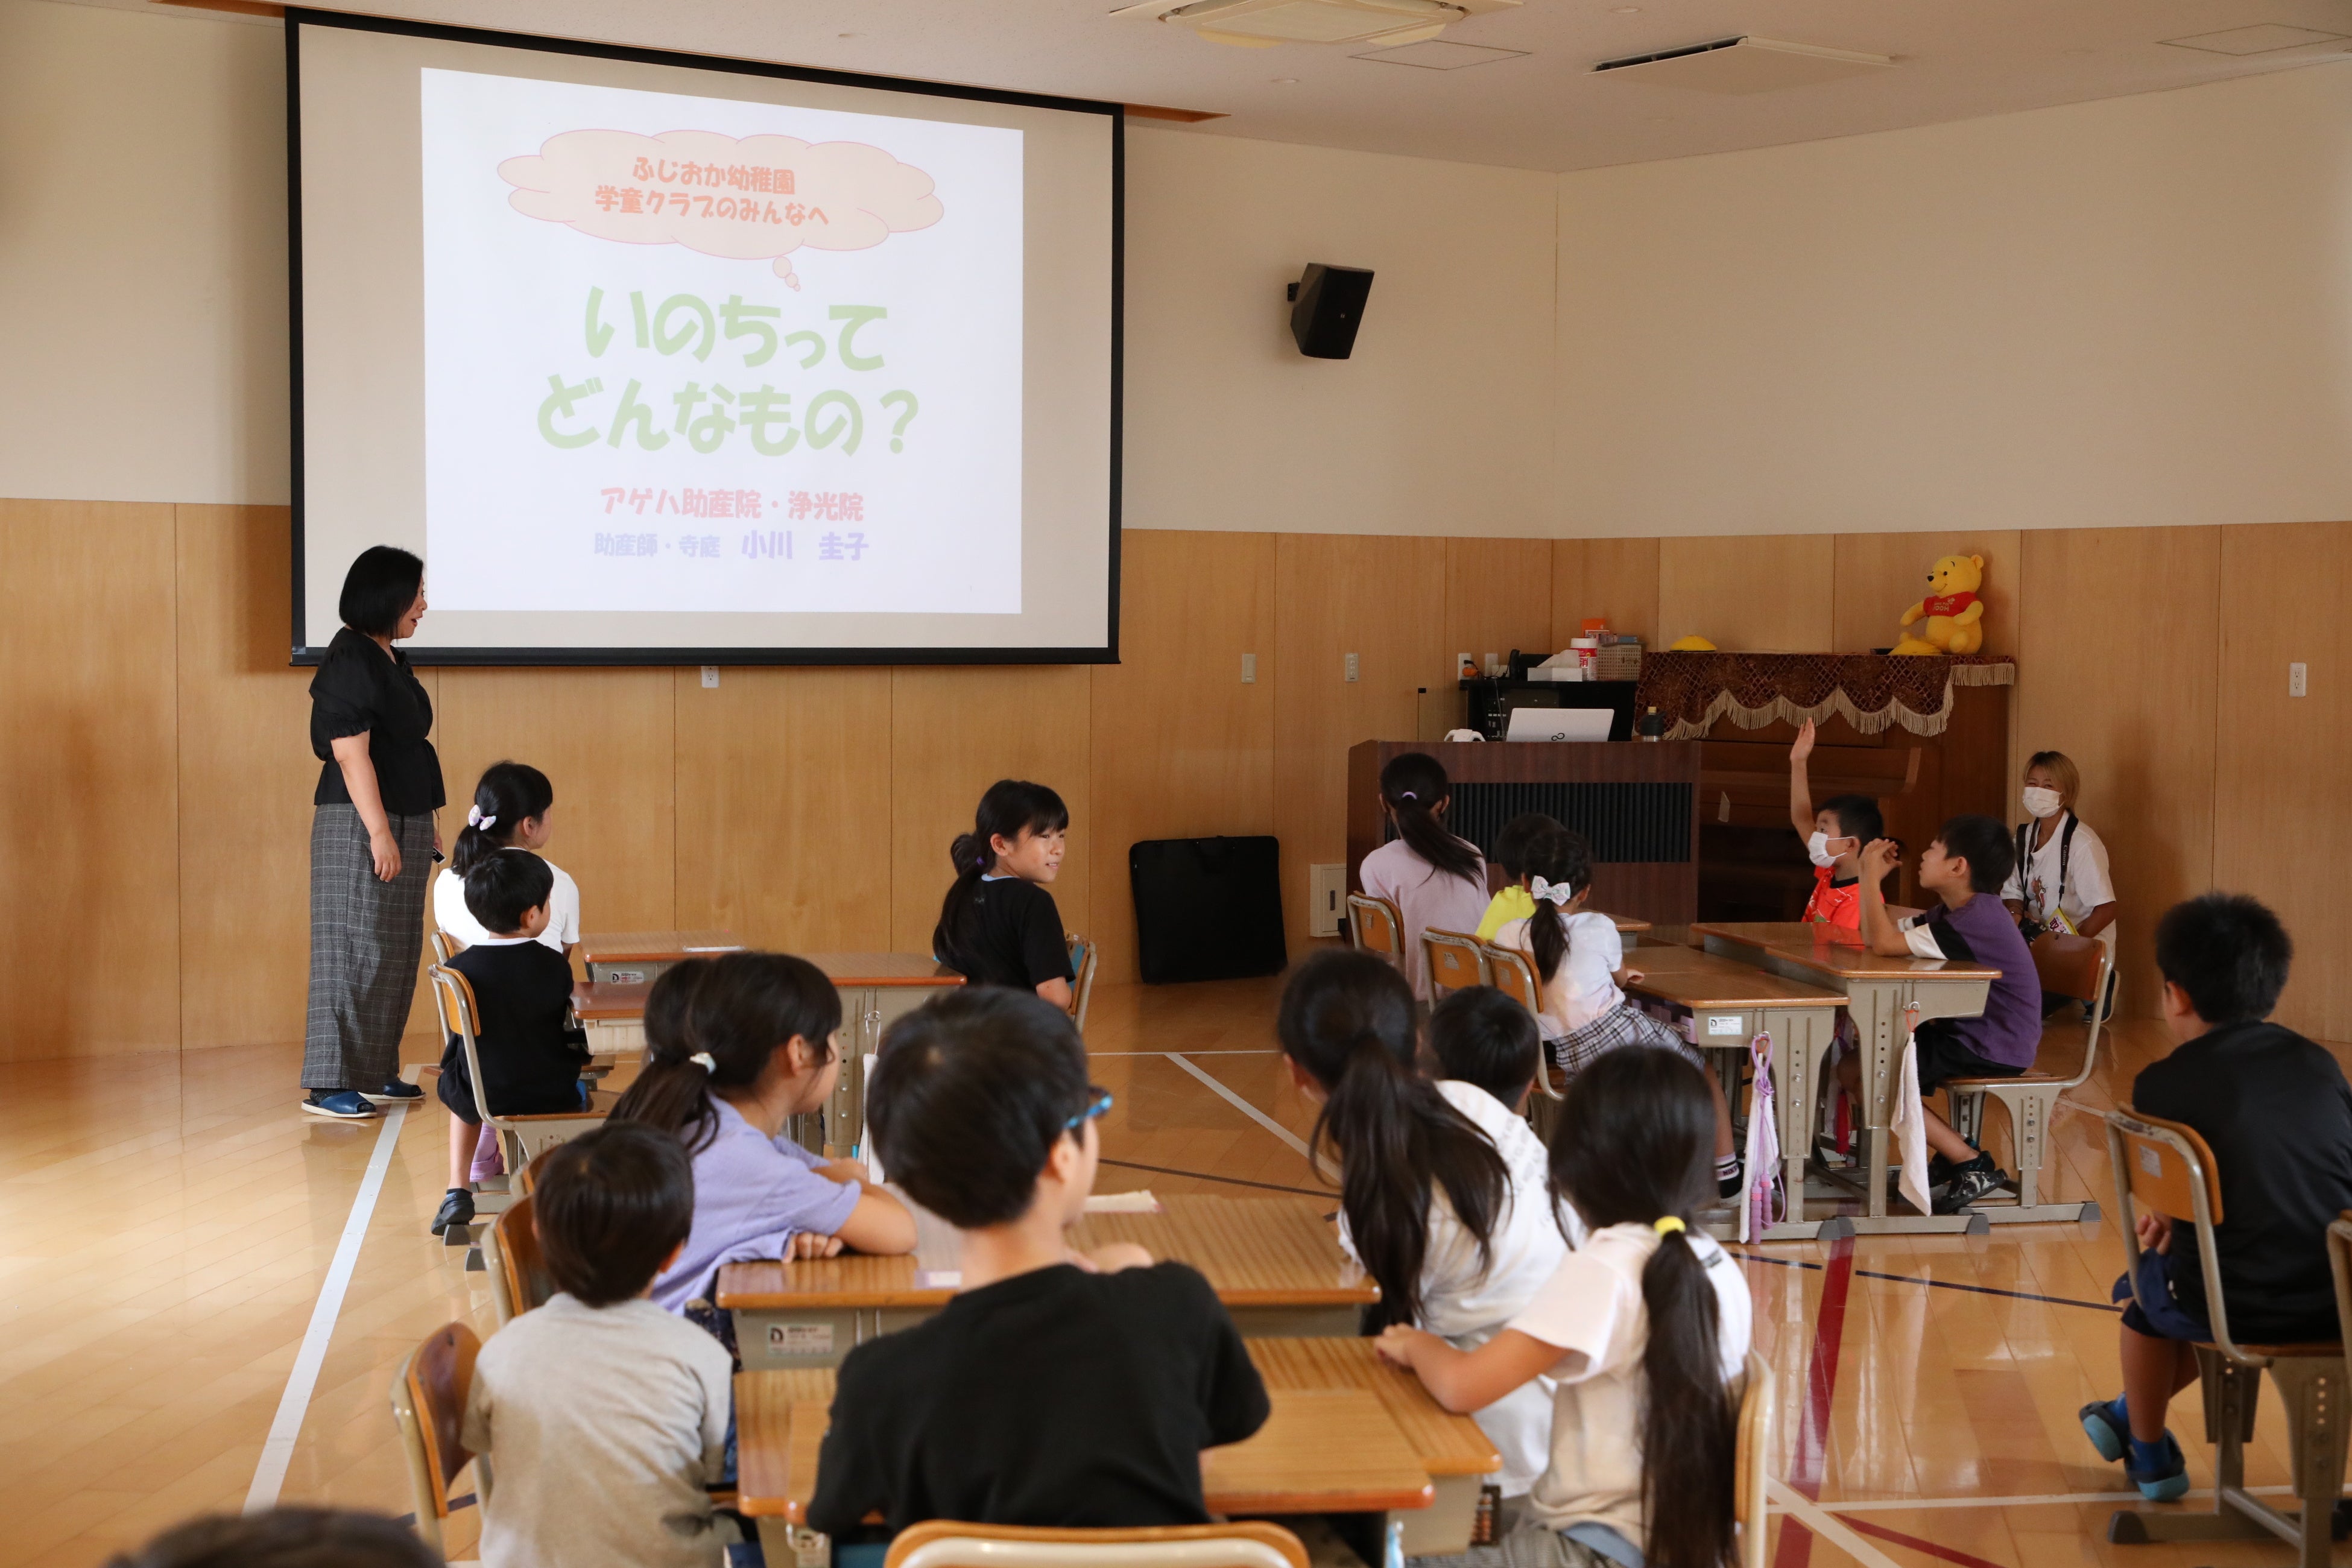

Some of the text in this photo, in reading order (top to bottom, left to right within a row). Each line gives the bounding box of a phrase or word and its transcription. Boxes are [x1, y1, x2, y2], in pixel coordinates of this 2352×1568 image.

[631, 156, 796, 195] ふじおか幼稚園
[595, 185, 830, 227] 学童クラブのみんなへ
[585, 285, 888, 372] いのちって
[537, 373, 919, 457] どんなもの？
[741, 530, 794, 560] 小川
[818, 531, 870, 561] 圭子
